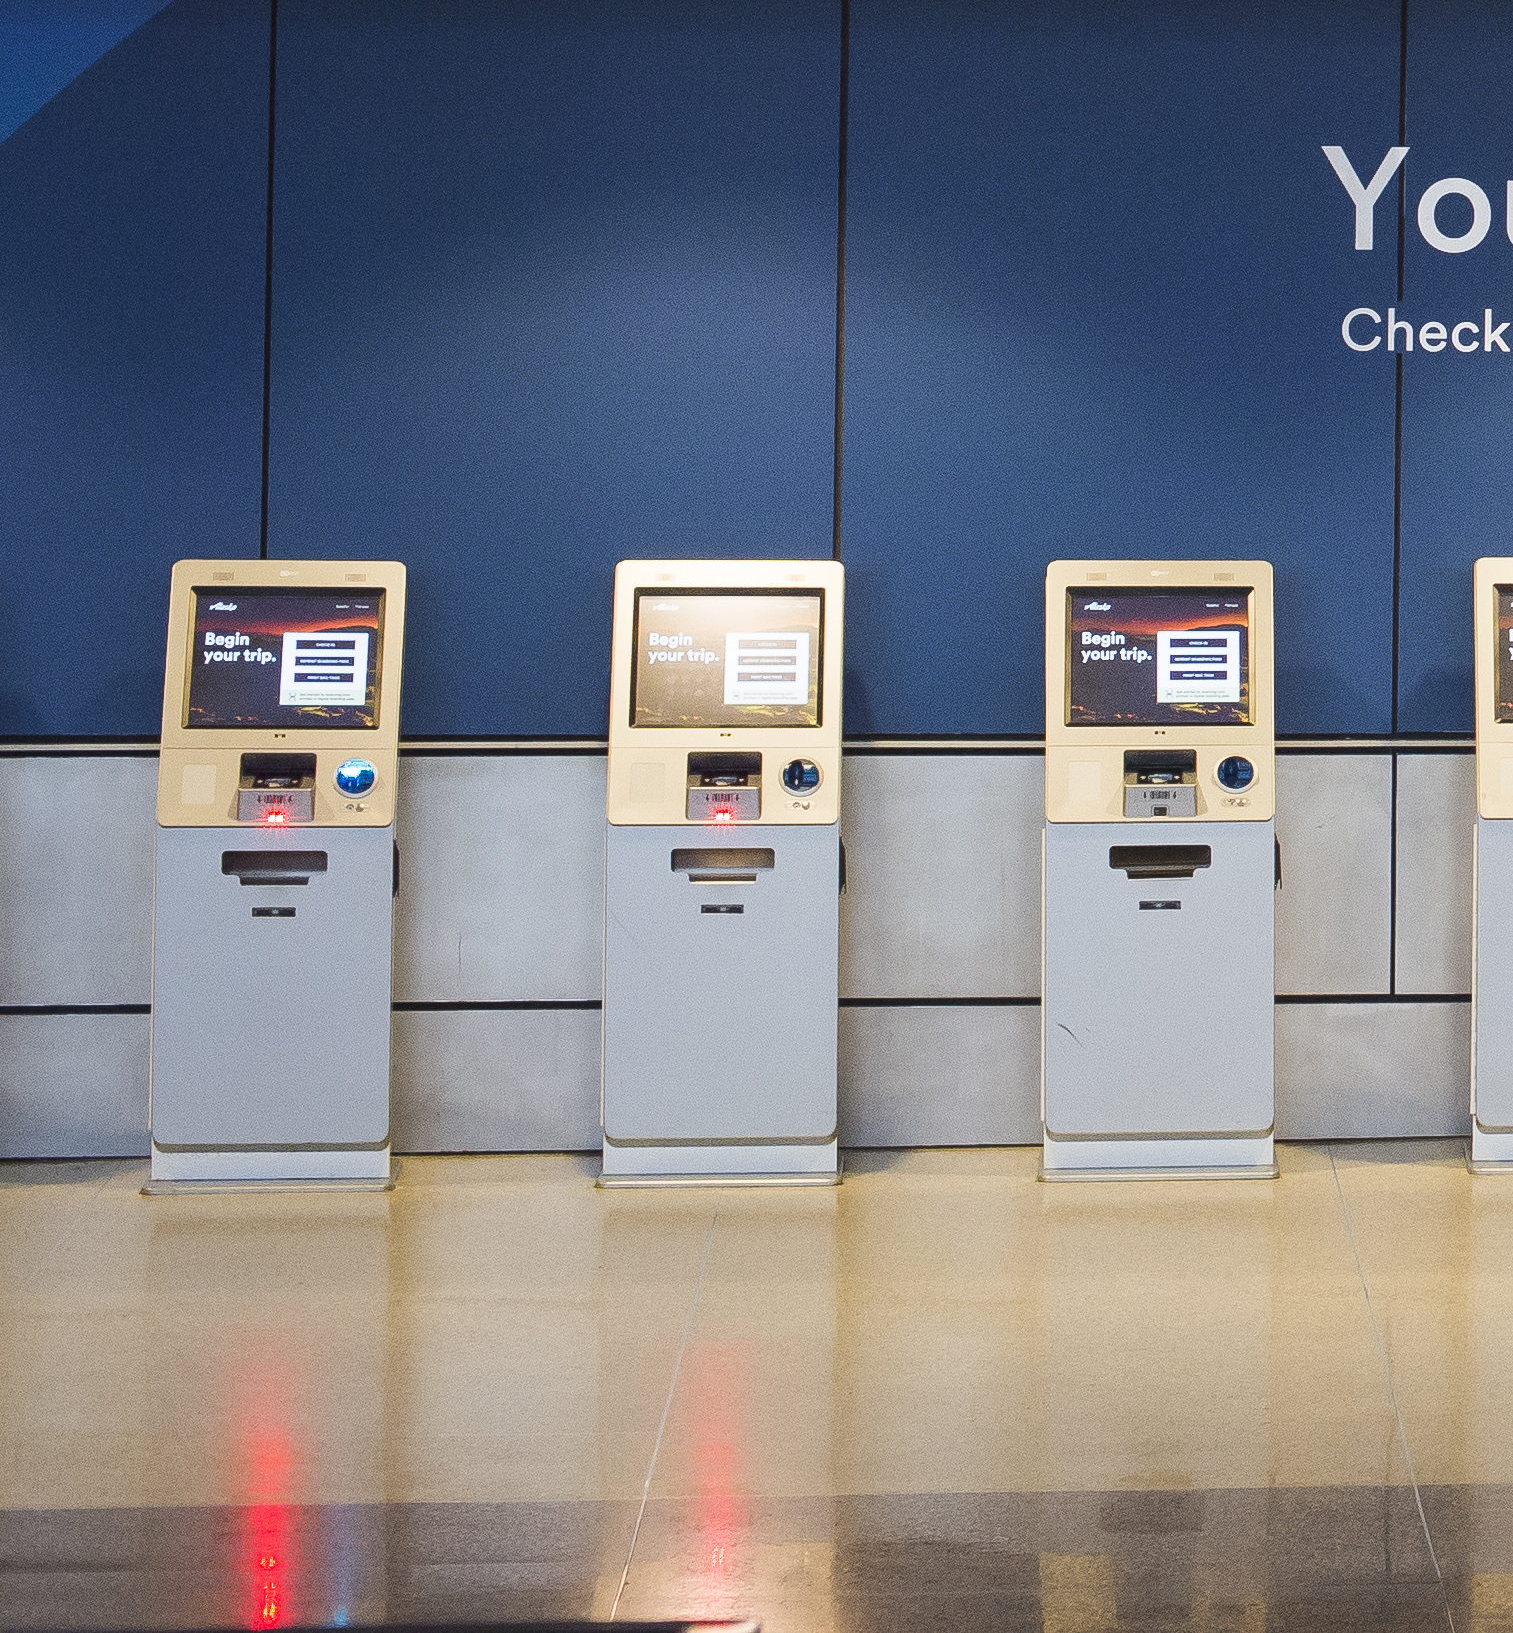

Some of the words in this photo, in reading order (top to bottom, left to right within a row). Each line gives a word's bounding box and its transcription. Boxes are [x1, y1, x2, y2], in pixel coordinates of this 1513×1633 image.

[1341, 307, 1511, 353] Check
[204, 631, 249, 648] Begin
[648, 631, 692, 647] Begin
[1081, 630, 1125, 646] Begin
[203, 649, 242, 664] your
[243, 648, 276, 664] trip.
[648, 649, 684, 664] your
[686, 649, 719, 664] trip.
[1081, 648, 1118, 663] your
[1120, 647, 1152, 662] trip.
